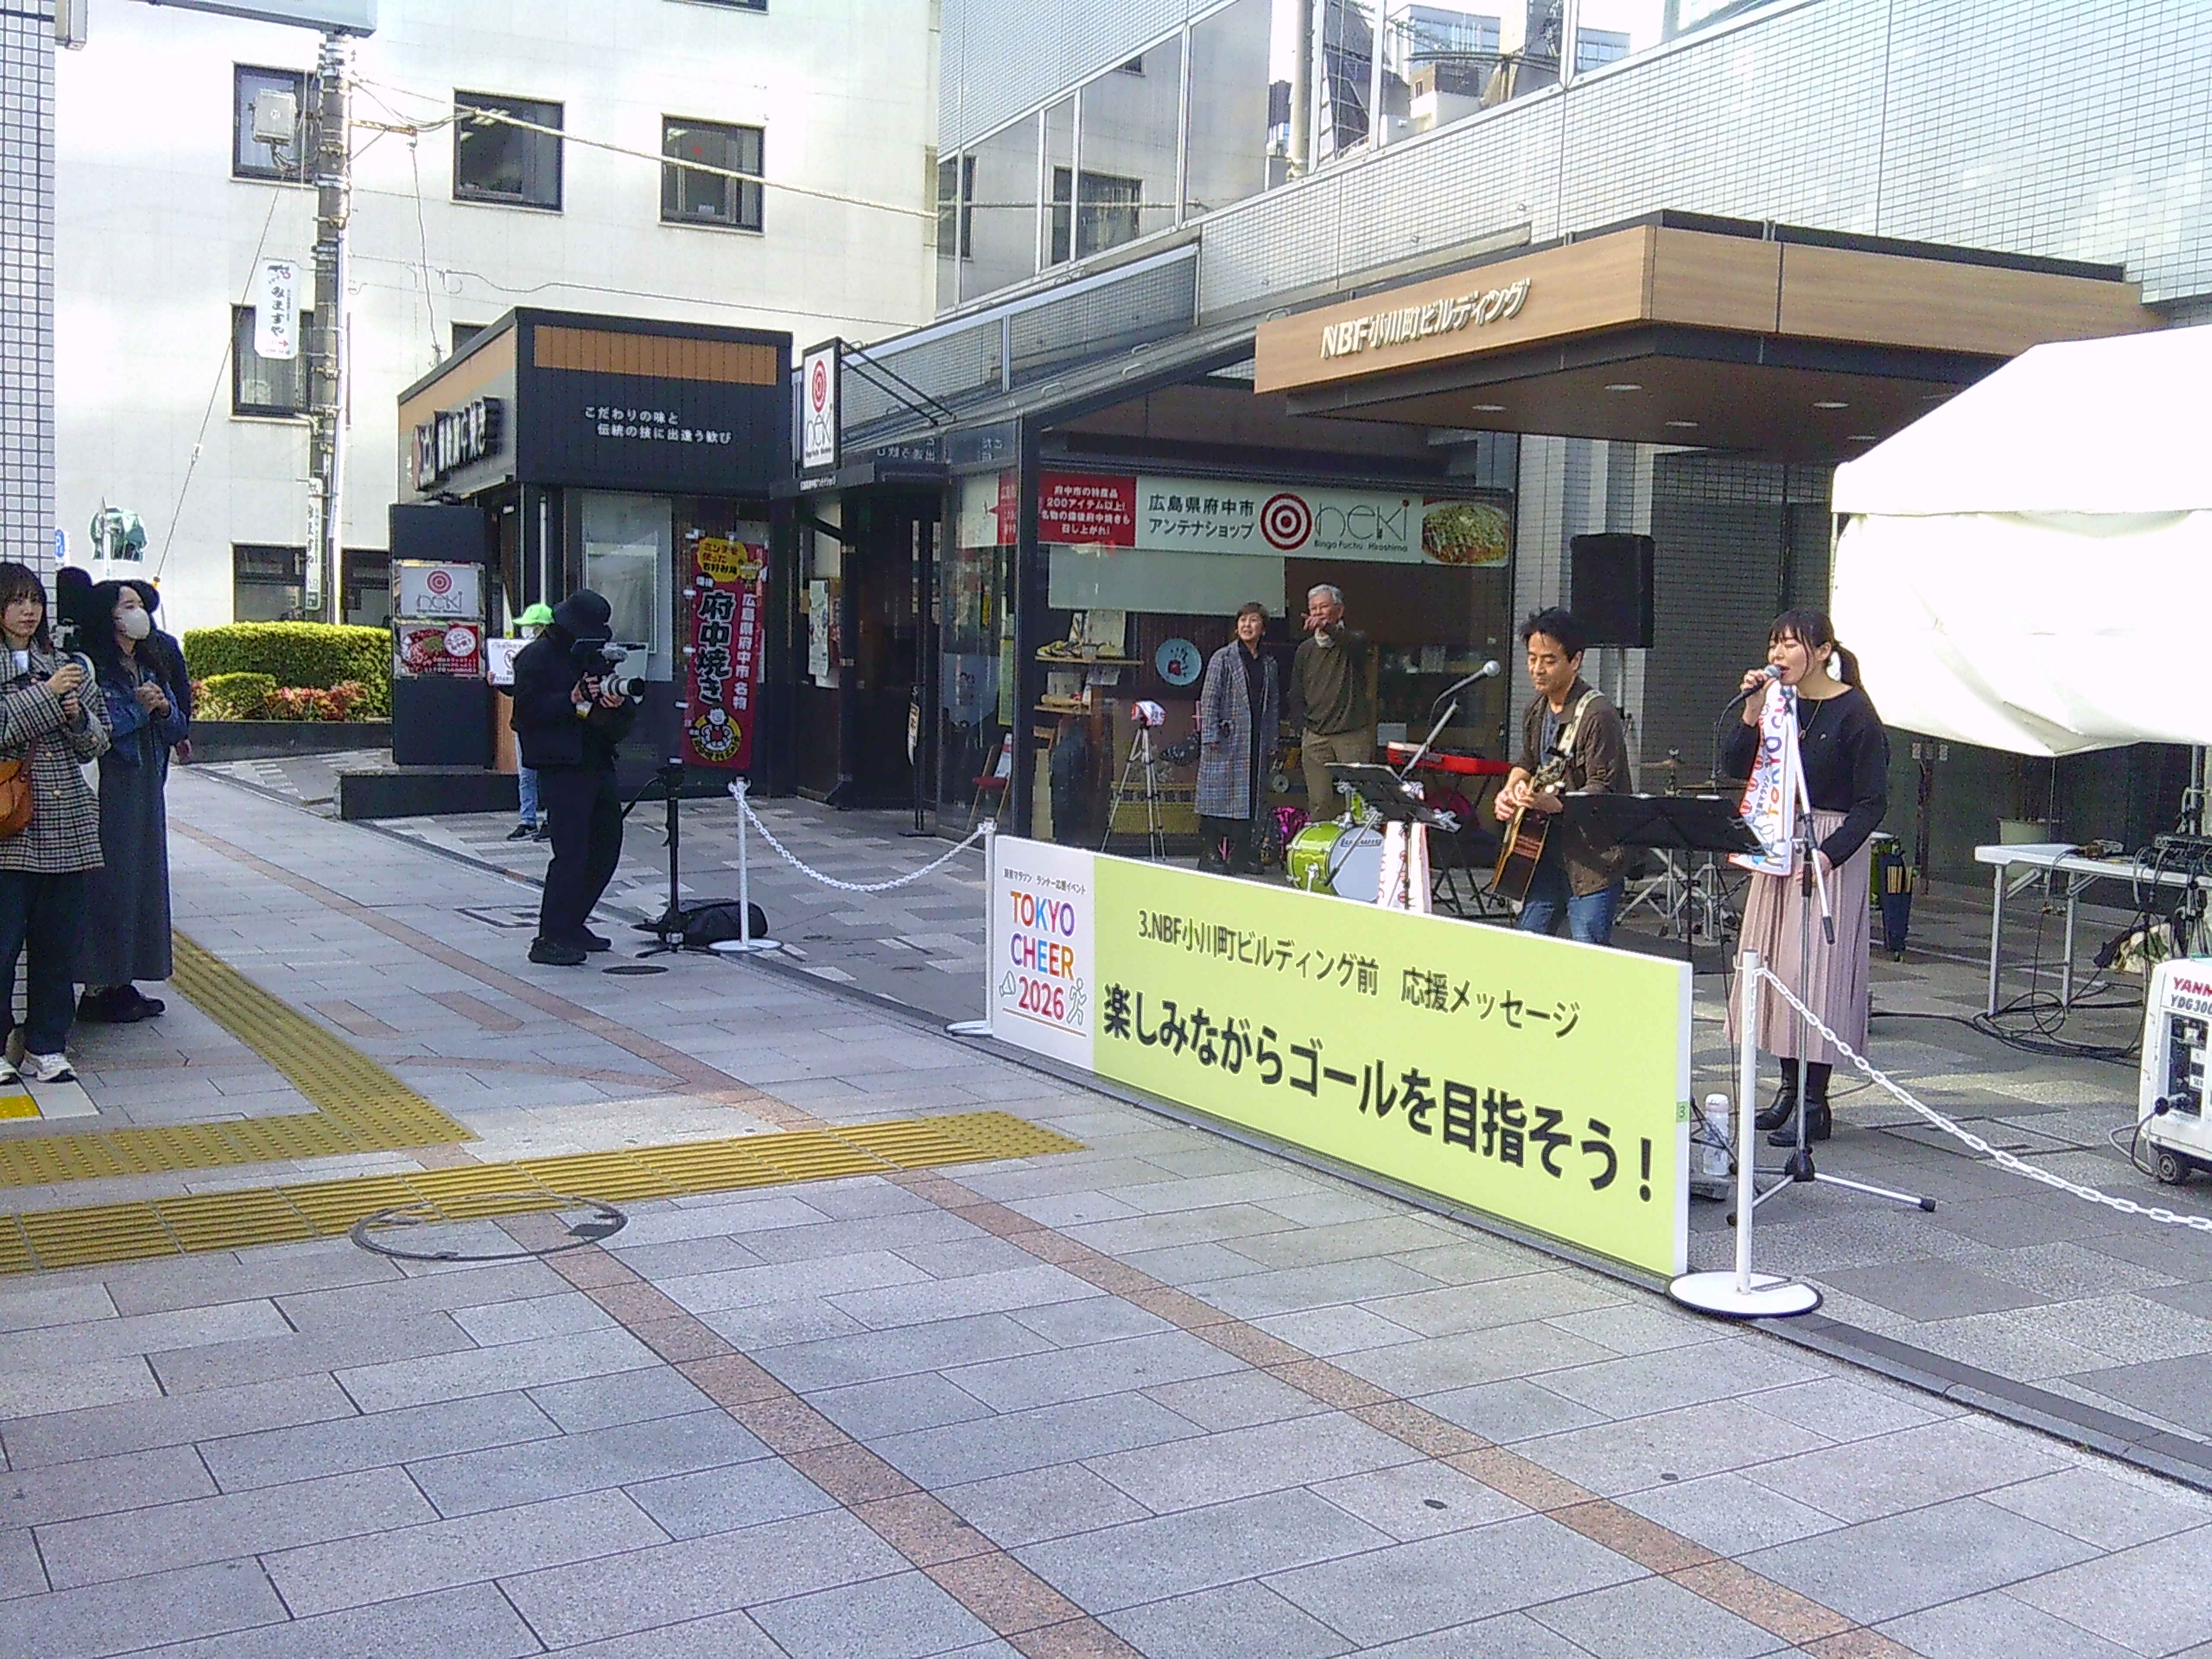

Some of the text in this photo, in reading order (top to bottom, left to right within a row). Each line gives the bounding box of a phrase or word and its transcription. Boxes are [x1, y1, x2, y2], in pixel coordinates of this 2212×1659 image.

[1320, 277, 1532, 359] NBF小川町ビルディング
[585, 406, 679, 425] こだわりの味と
[1054, 484, 1119, 499] 府中市の特産品
[1148, 494, 1255, 516] 広島県府中市
[1148, 518, 1255, 540] アンテナショップ
[1315, 498, 1410, 542] neki
[697, 591, 736, 704] 府中焼き
[1036, 875, 1087, 895] ランナー応援イベント
[1010, 890, 1075, 937] TOKYO
[1011, 933, 1074, 981] CHEER
[1138, 909, 1580, 1039] 3.NBF小川町ビルディング前 応援メッセージ
[1019, 976, 1065, 1021] 2026
[1103, 982, 1653, 1203] 楽しみながらゴールを目指そう！
[1679, 1105, 1686, 1119] 3
